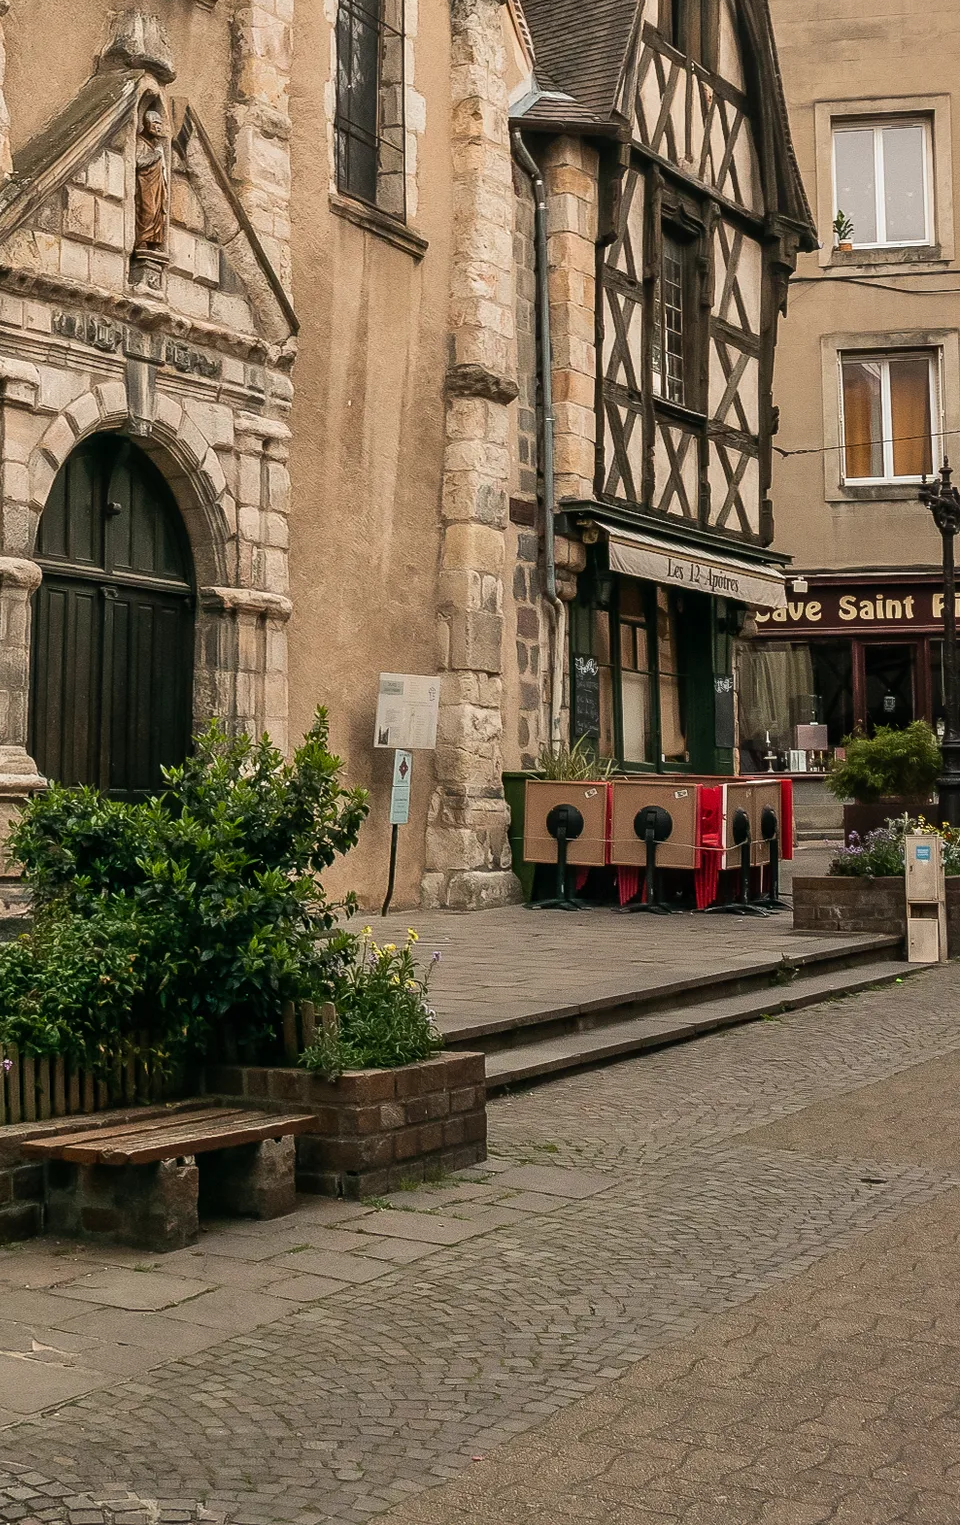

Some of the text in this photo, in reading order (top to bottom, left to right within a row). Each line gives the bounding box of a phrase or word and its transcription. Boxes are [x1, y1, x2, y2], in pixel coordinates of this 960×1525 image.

[667, 558, 740, 593] Les 12 Apôtres
[839, 594, 915, 621] Saint
